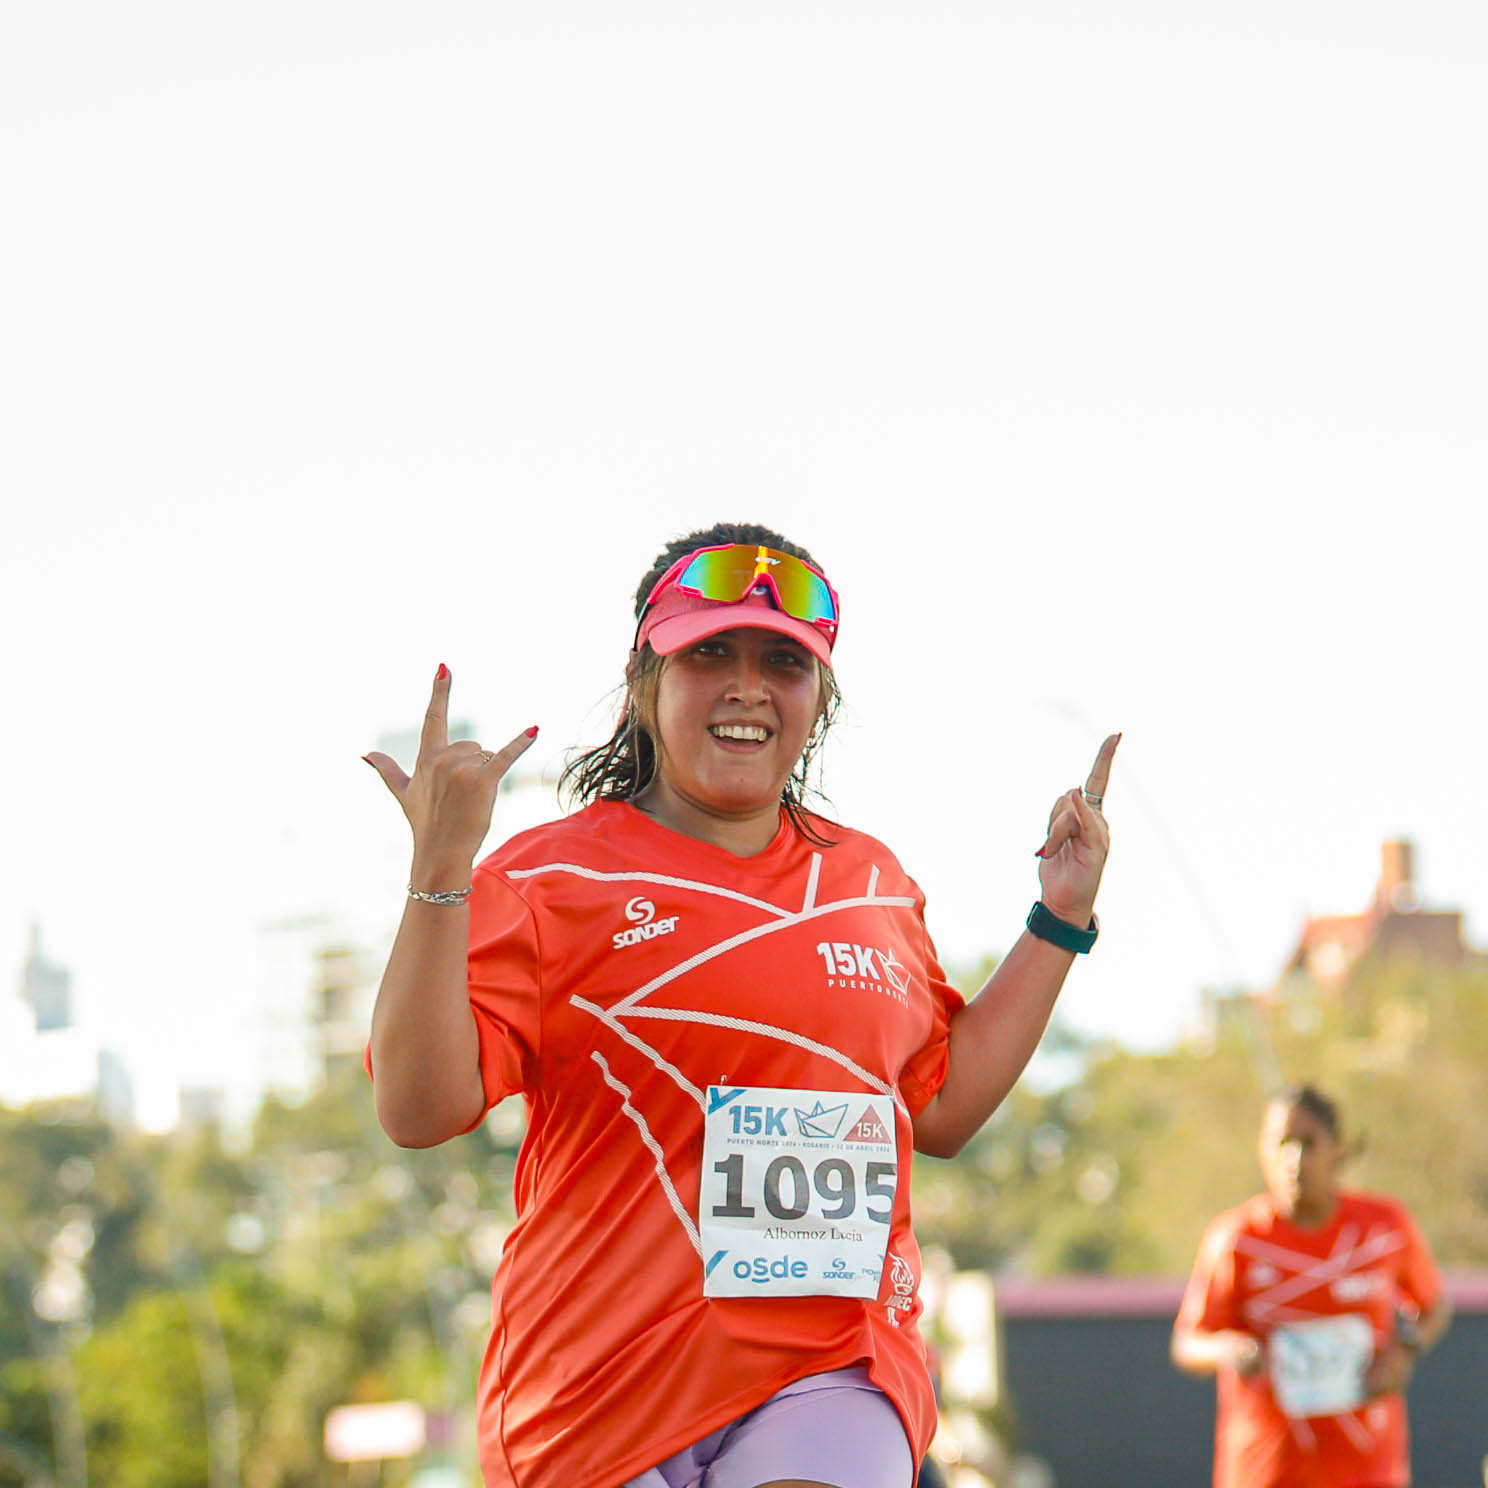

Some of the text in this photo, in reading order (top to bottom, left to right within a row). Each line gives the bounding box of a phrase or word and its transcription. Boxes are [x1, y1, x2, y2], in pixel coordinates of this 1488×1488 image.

[816, 942, 881, 981] 15K
[728, 1104, 789, 1137] 15K
[856, 1121, 883, 1139] 15K
[712, 1153, 898, 1225] 1095
[763, 1226, 827, 1241] Albornoz
[733, 1254, 809, 1280] osde
